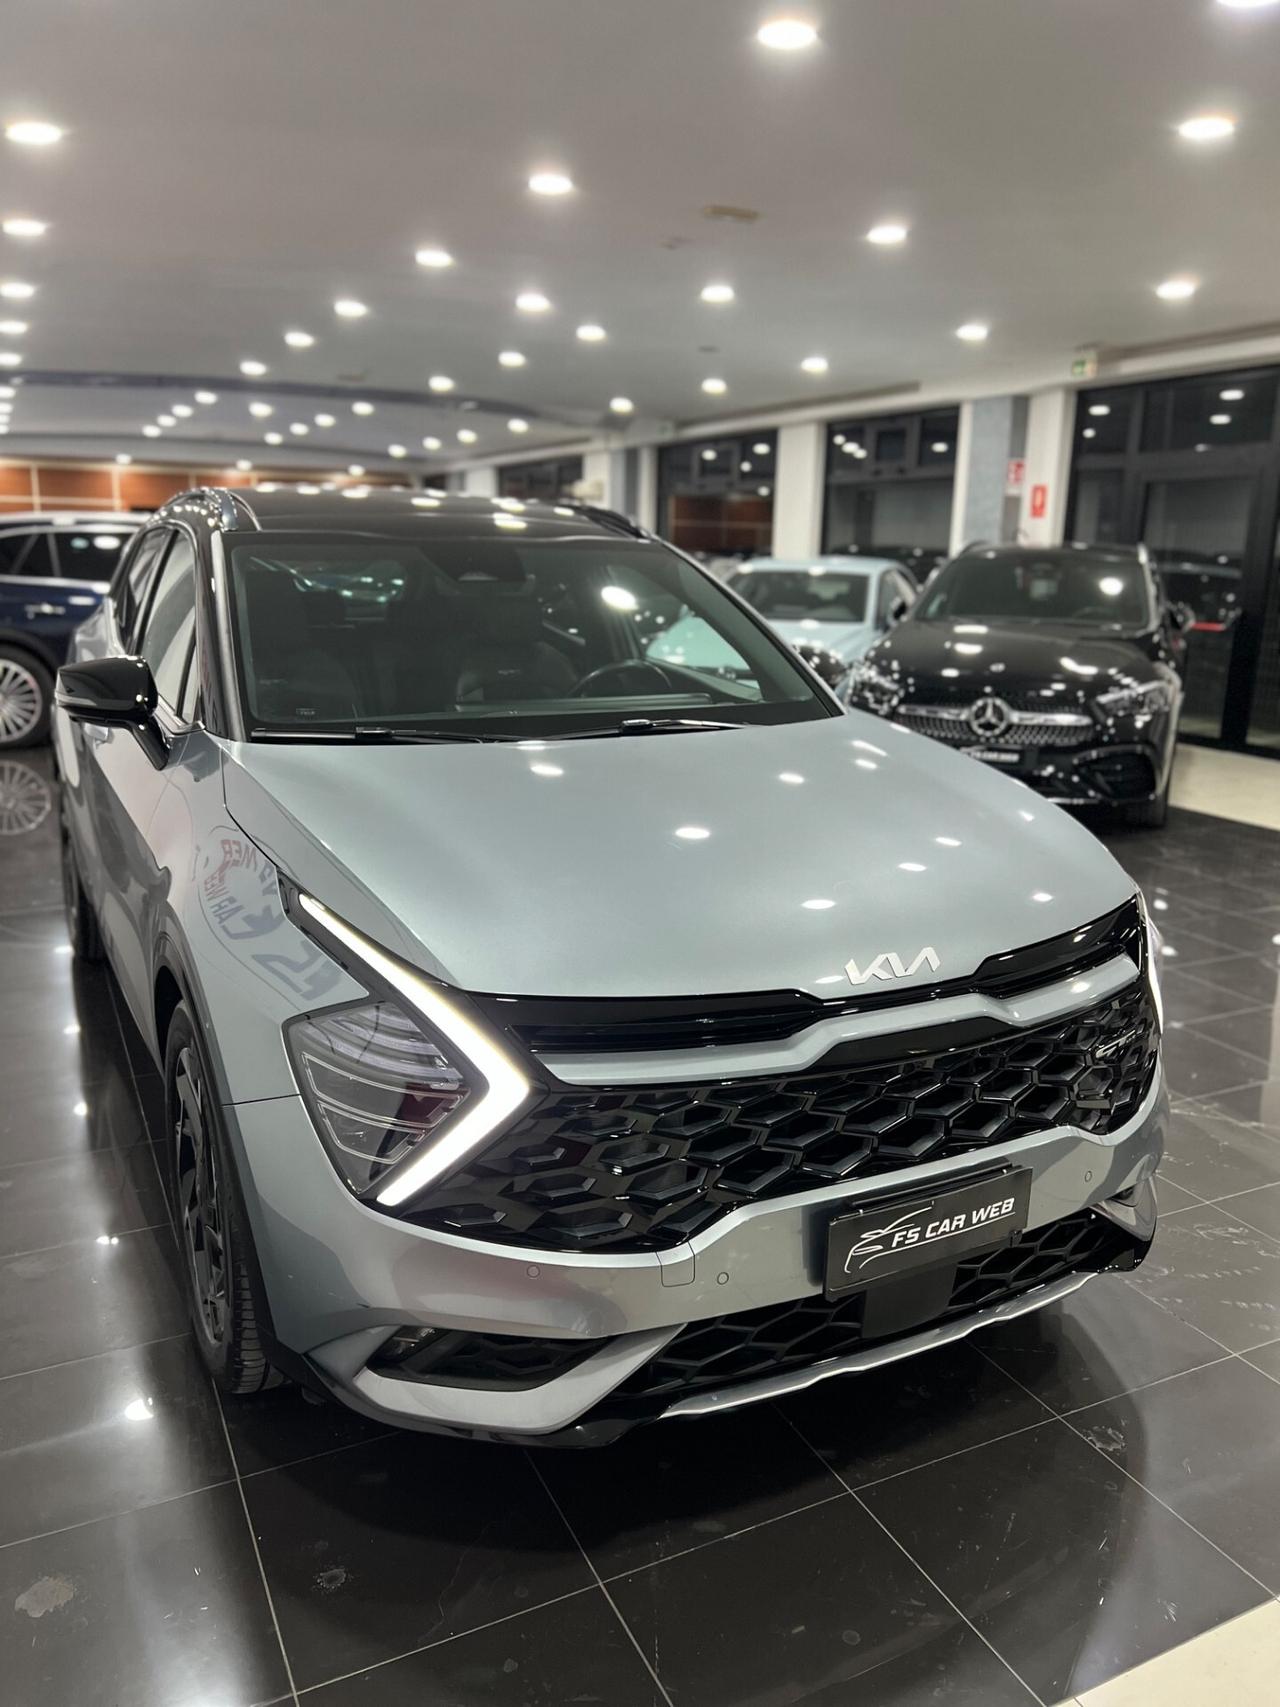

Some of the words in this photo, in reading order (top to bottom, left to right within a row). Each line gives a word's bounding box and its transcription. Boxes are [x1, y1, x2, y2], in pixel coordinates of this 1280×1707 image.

[844, 946, 941, 985] KIA
[891, 1227, 921, 1248] FS
[925, 1214, 967, 1239] CAR
[971, 1197, 1015, 1225] WEB
